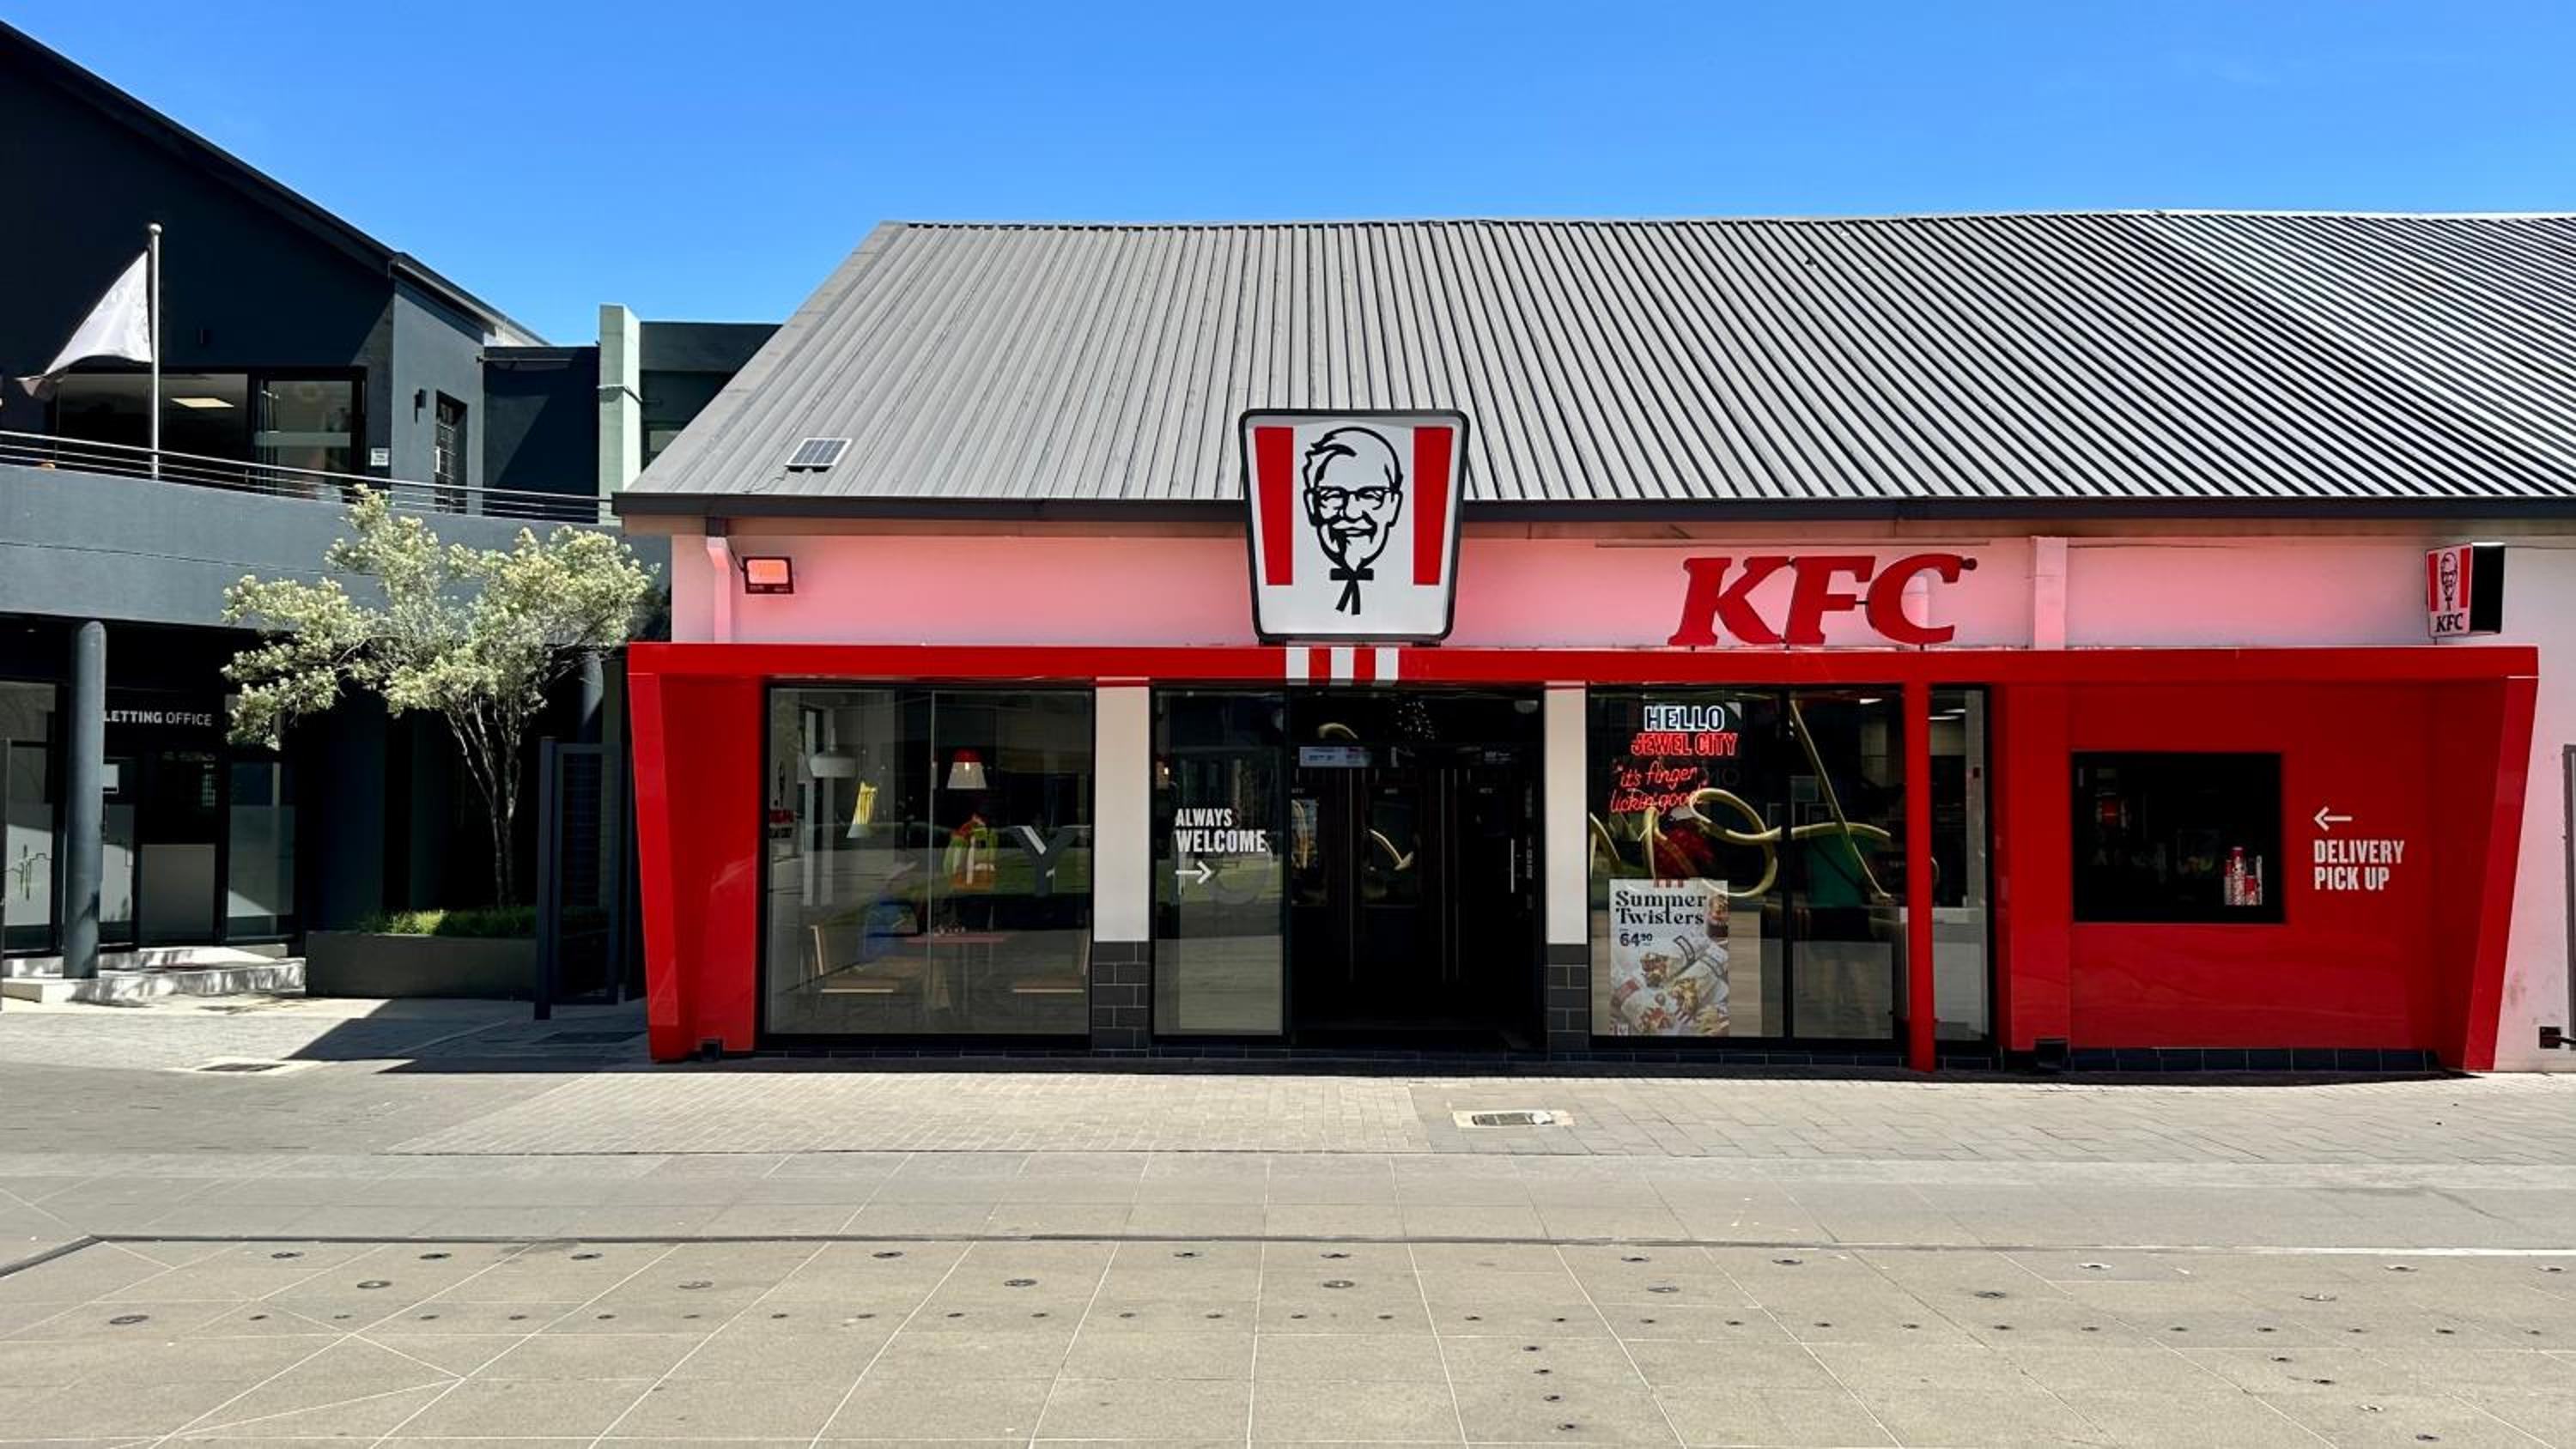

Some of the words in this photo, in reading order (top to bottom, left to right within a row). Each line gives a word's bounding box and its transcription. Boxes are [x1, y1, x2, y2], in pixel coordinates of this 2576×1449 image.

[1668, 554, 1965, 646] KFC
[2436, 613, 2464, 633] KFC
[103, 710, 162, 724] LETTING
[166, 712, 213, 727] OFFICE
[1643, 705, 1725, 732] HELLO
[1631, 732, 1693, 756] JEWEL
[1694, 732, 1738, 756] CITY
[1646, 760, 1698, 791] finger
[1175, 808, 1232, 827] ALWAYS
[1175, 828, 1267, 852] WELCOME
[2313, 840, 2404, 864] DELIVERY
[2313, 866, 2360, 890] PICK
[2364, 866, 2390, 890] UP
[1615, 890, 1706, 907] Summer
[1615, 906, 1704, 925] Twisters
